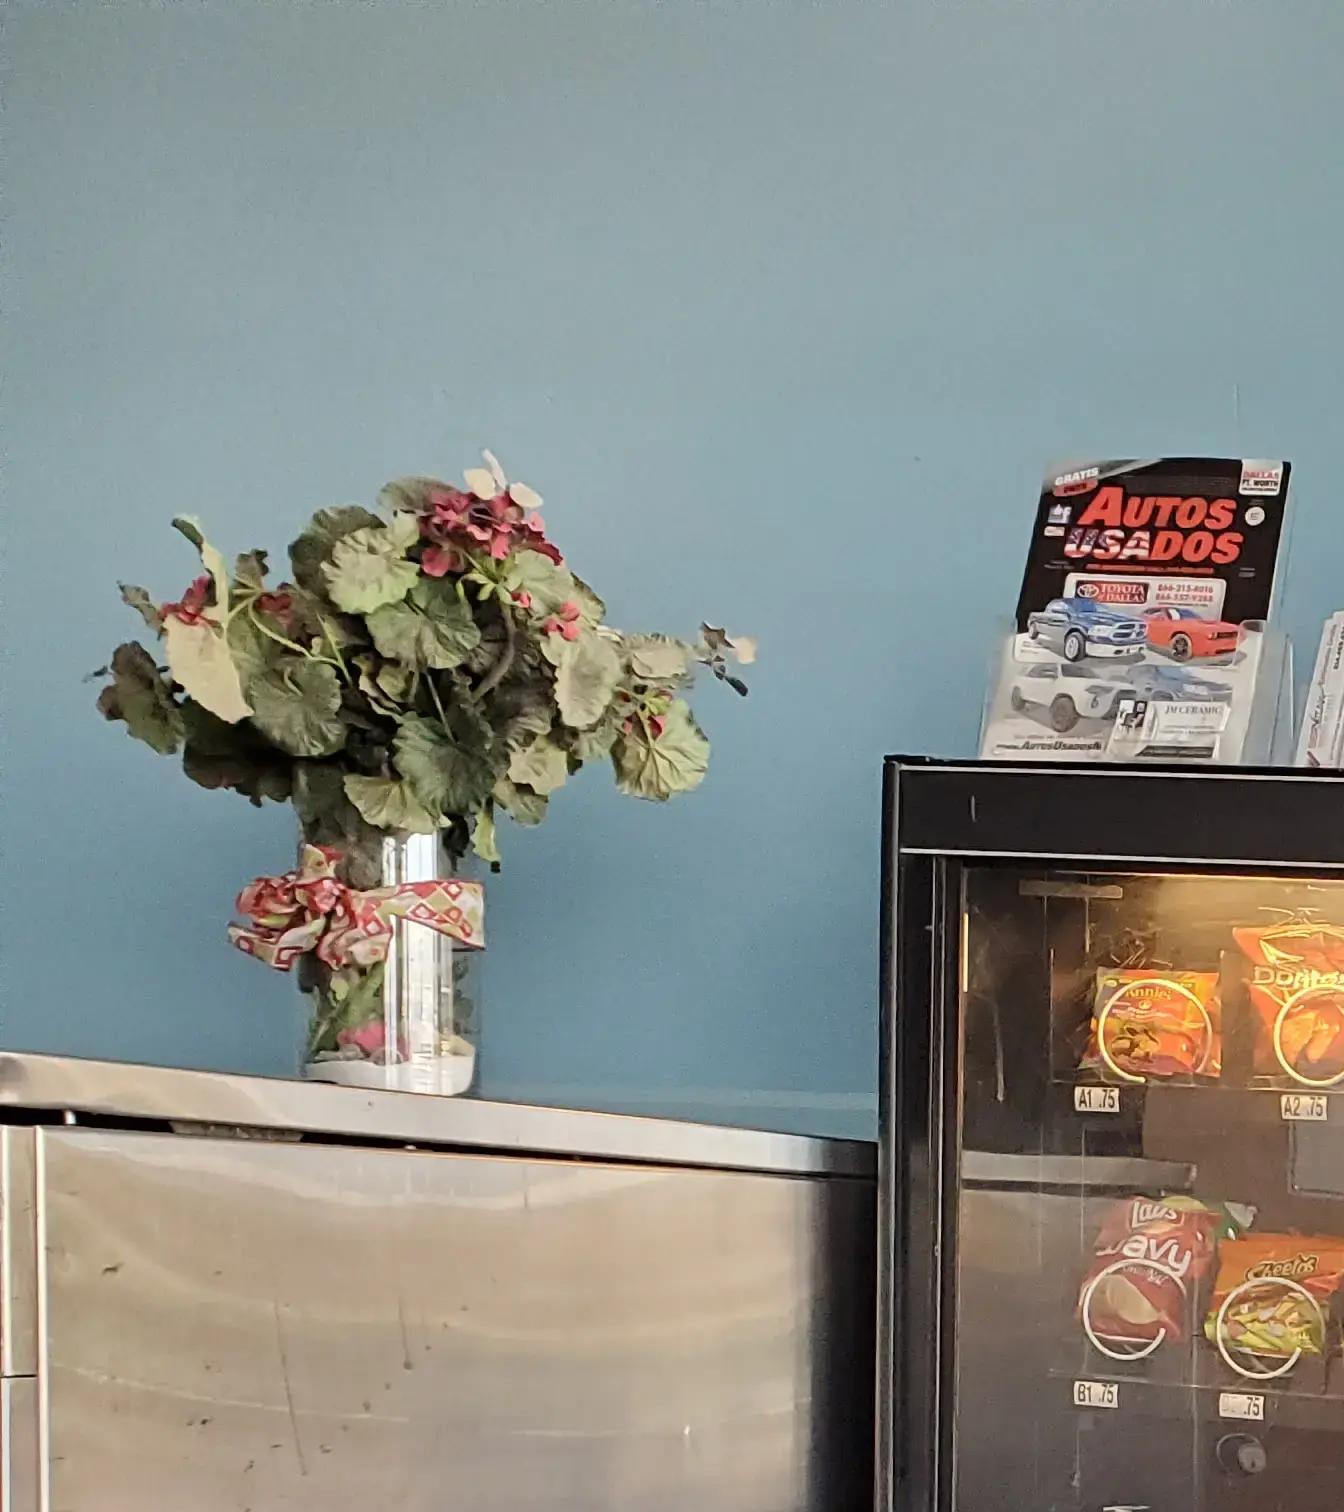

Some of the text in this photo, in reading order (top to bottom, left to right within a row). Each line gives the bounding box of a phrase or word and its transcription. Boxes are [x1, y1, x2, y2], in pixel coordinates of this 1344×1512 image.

[1055, 467, 1099, 486] GRATIS
[1076, 486, 1238, 529] AUTOS
[1063, 529, 1245, 565] USADOS
[1101, 583, 1145, 594] TOYOTA
[1107, 593, 1145, 602] DALLAS
[1079, 1089, 1115, 1109] A1 .75
[1284, 1097, 1323, 1117] A2 .75
[1245, 1255, 1318, 1280] Cheetos
[1077, 1384, 1114, 1404] B1 .75
[1244, 1398, 1260, 1416] .75
